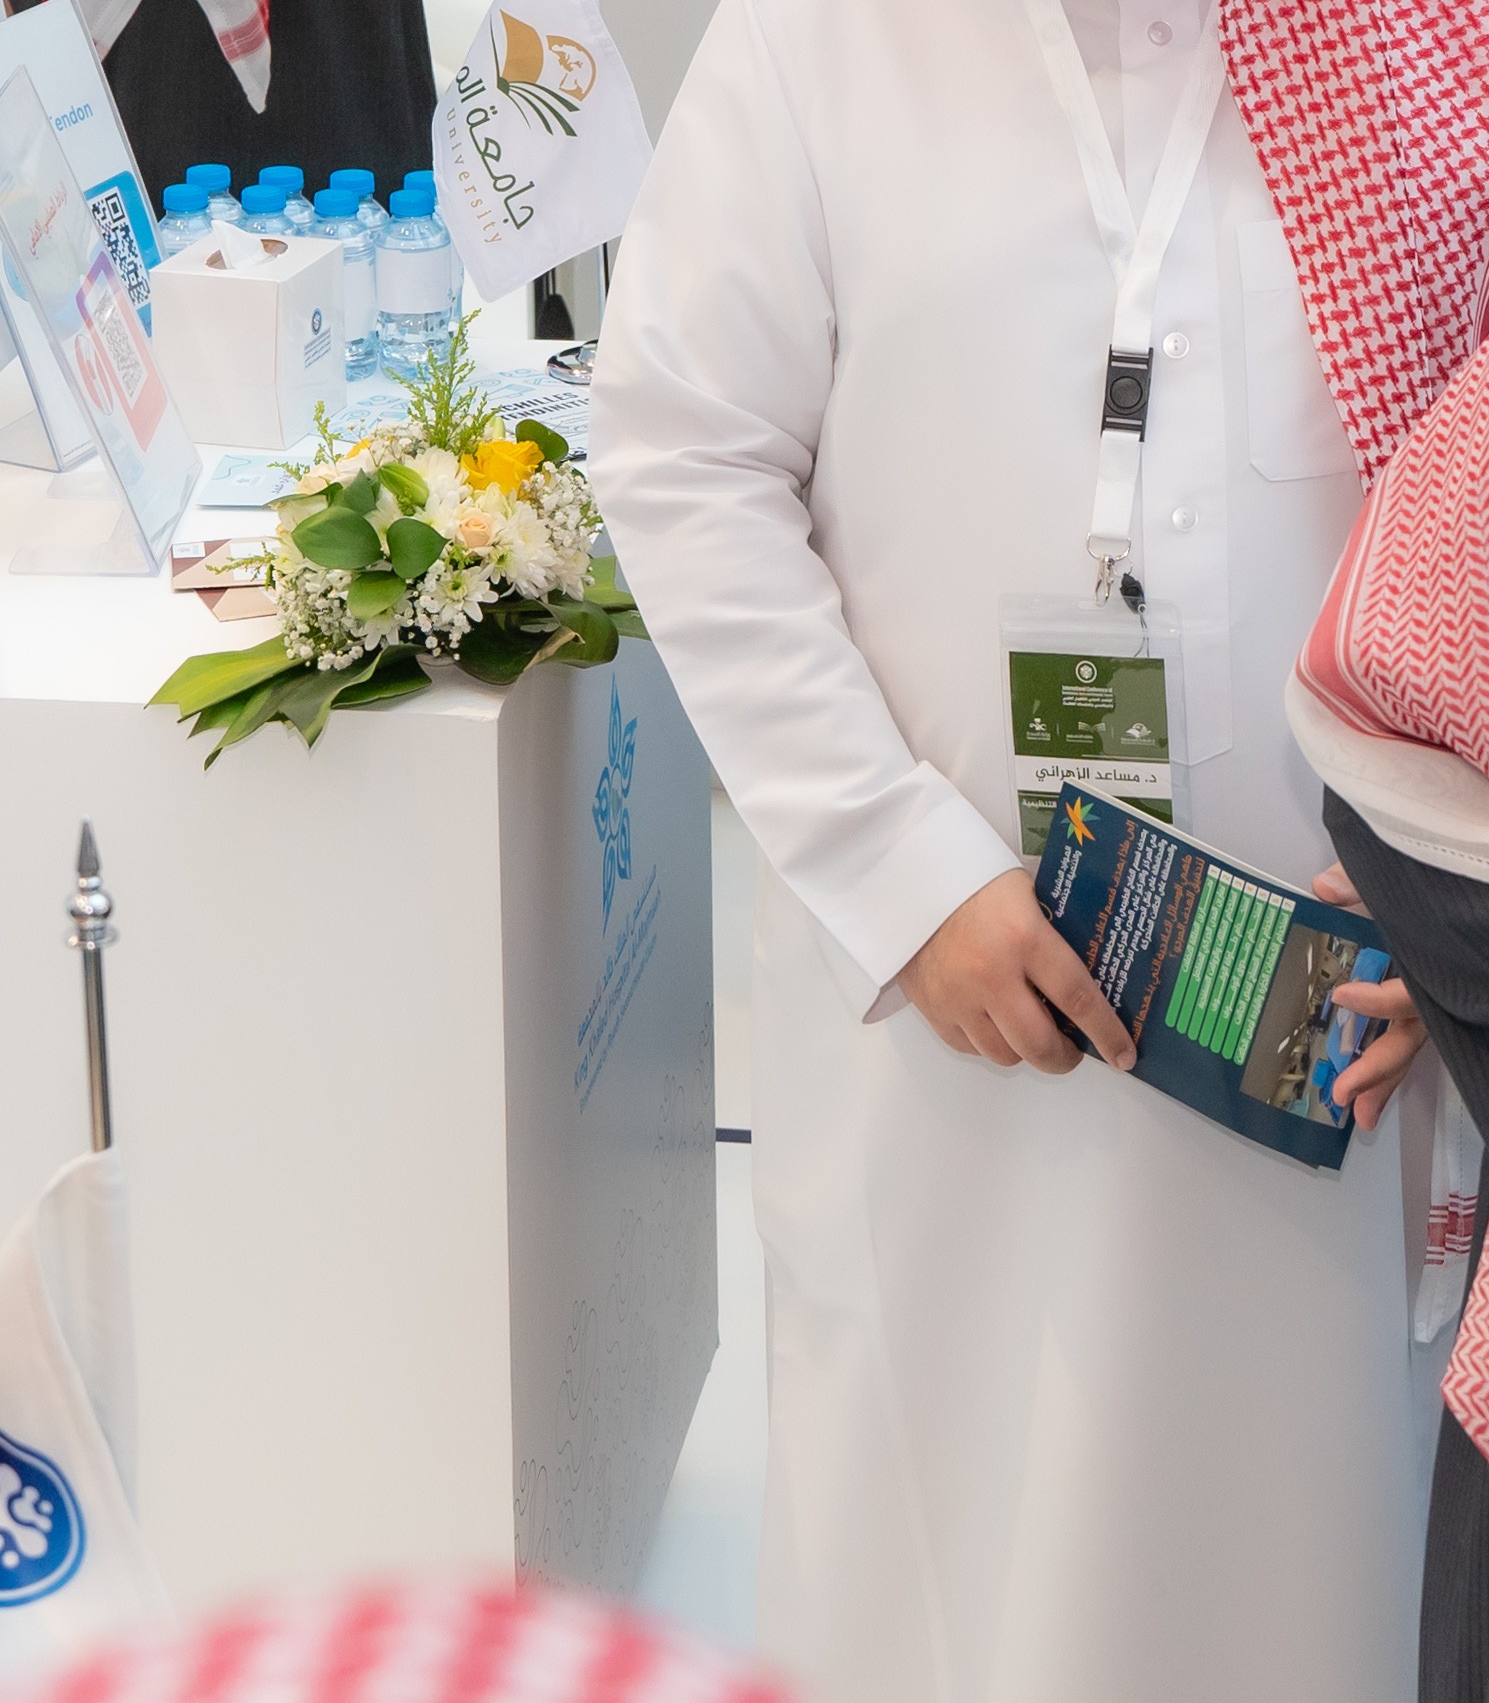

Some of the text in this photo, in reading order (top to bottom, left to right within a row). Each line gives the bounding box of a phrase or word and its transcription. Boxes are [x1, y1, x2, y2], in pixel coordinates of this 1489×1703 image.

[50, 101, 93, 132] endon
[445, 106, 503, 245] University
[466, 105, 534, 229] جامعة
[1036, 765, 1090, 782] الزهراني
[1095, 769, 1140, 783] مساعد
[1135, 828, 1148, 851] يهدف
[1050, 844, 1072, 899] الموارد البشرية
[1109, 857, 1126, 887] يهدف
[1130, 851, 1143, 870] قسم
[1140, 846, 1155, 869] المركز
[1150, 838, 1168, 876] والمحافظة
[1160, 843, 1177, 881] والمحافظة
[1053, 849, 1082, 918] والتنمية الاجتماعية
[1101, 887, 1117, 914] قسم
[1116, 887, 1132, 917] الطبيعي
[1092, 912, 1110, 942] العلاج
[1112, 916, 1123, 931] إلى
[1101, 929, 1118, 964] المحافظة
[1114, 930, 1130, 958] الحركي
